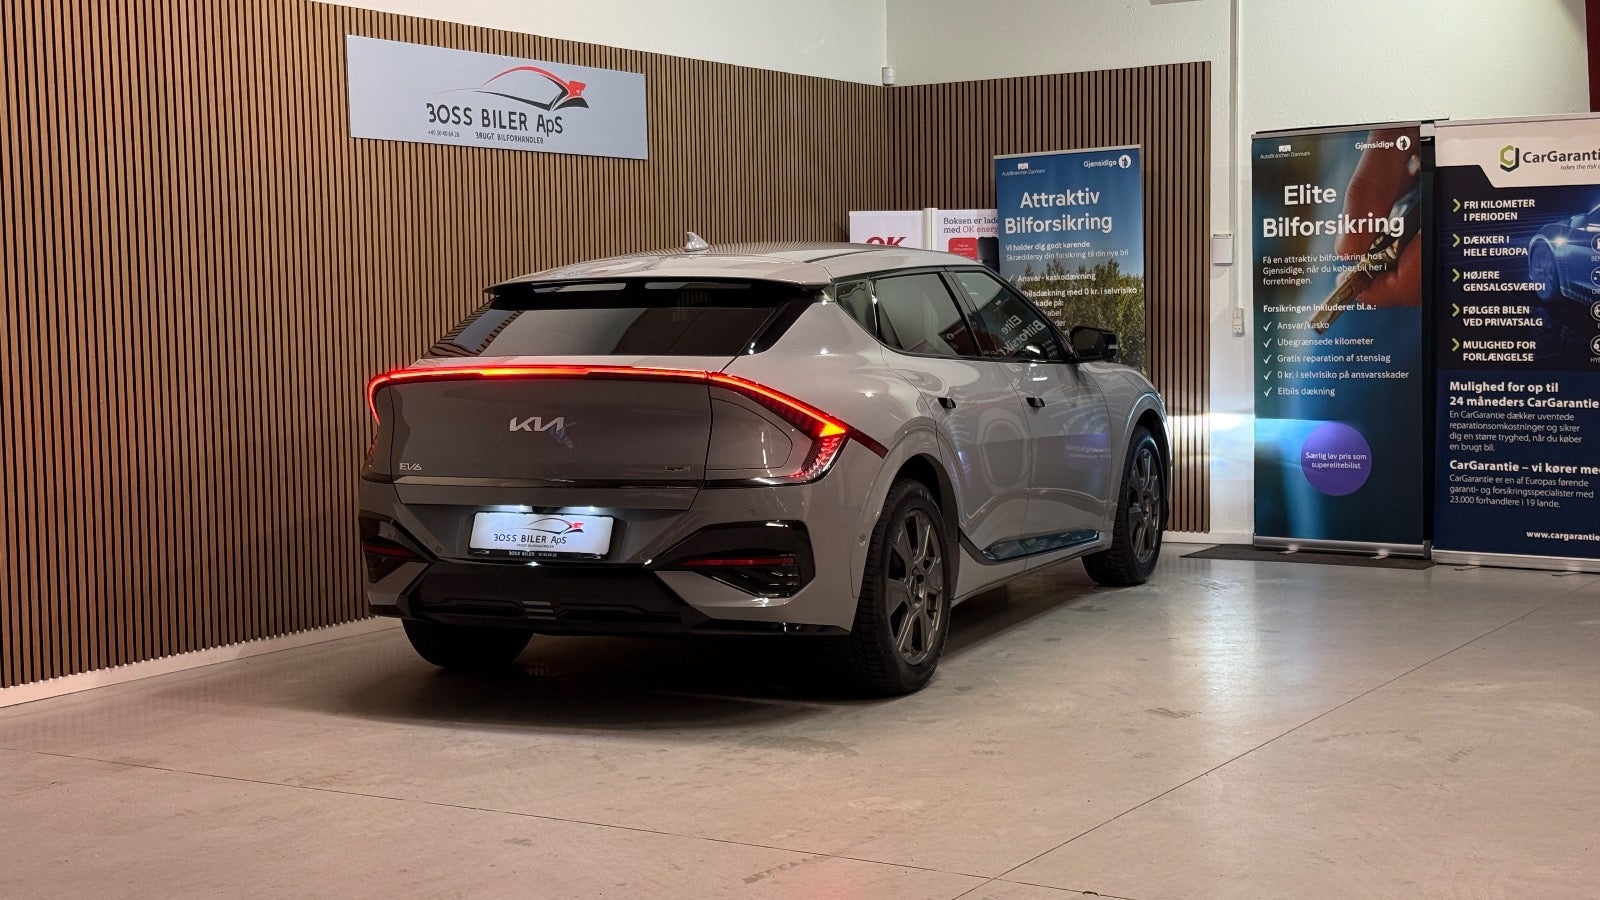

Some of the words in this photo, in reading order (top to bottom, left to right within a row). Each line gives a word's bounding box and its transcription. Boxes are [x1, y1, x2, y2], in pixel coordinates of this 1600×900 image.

[482, 109, 528, 131] BILER
[536, 114, 563, 137] ApS
[497, 134, 544, 144] BILFORHANDLER
[1355, 140, 1394, 150] Gjensidige
[1083, 160, 1117, 168] Gjensidige
[1020, 187, 1100, 209] Attraktiv
[1284, 184, 1337, 206] Elite
[1464, 201, 1478, 209] FRI
[1481, 199, 1535, 209] KILOMETER
[1469, 212, 1517, 221] PERIODEN
[1005, 213, 1112, 234] Bilforsikring
[1263, 212, 1404, 238] Bilforsikring
[977, 226, 999, 234] energ
[1463, 236, 1504, 244] DÆKKER
[1035, 243, 1045, 251] dig
[1047, 242, 1062, 251] godt
[1063, 241, 1090, 249] kørende
[1006, 253, 1042, 261] Skræddersy
[1056, 251, 1086, 260] forsikring
[1106, 250, 1118, 258] nye
[1464, 249, 1487, 257] HELE
[1490, 248, 1528, 256] EUROPA
[1263, 256, 1272, 264] Få
[1284, 255, 1317, 263] attraktiv
[1319, 253, 1365, 263] bilforsikring
[1263, 266, 1304, 276] Gjensidige,
[1306, 265, 1319, 274] når
[1321, 265, 1331, 273] du
[1332, 264, 1356, 273] køber
[1369, 263, 1383, 271] her
[1045, 272, 1096, 281] kaskodækning
[1463, 271, 1500, 279] HØJERE
[1263, 277, 1312, 286] forretningen.
[1463, 283, 1545, 292] GENSALGSVÆRDI
[1263, 304, 1311, 314] Forsikringen
[1314, 303, 1355, 312] inkluderer
[1356, 303, 1376, 311] bl.a.:
[1463, 306, 1502, 315] FØLGER
[1502, 306, 1530, 314] BILEN
[1277, 322, 1329, 330] Ansvar/kasko
[1463, 318, 1482, 326] VED
[1485, 318, 1543, 326] PRIVATSALG
[1278, 338, 1333, 347] Ubegrænsede
[1463, 341, 1514, 349] MULIGHED
[1517, 341, 1536, 349] FOR
[1278, 354, 1301, 363] Gratis
[1303, 354, 1343, 364] reparation
[1356, 354, 1391, 363] stenslag
[1463, 353, 1534, 361] FORLÆNGELSE
[1339, 370, 1349, 380] på
[1351, 371, 1409, 379] ansvarsskader
[1278, 387, 1299, 395] Elbils
[1301, 387, 1335, 397] dækning
[1450, 381, 1504, 393] Mulighed
[1507, 382, 1525, 392] for
[1527, 384, 1543, 394] op
[1546, 383, 1558, 393] til
[1450, 397, 1463, 405] 24
[1467, 396, 1525, 407] måneders
[1527, 398, 1600, 409] CarGarantie
[1450, 411, 1459, 419] En
[1461, 411, 1505, 419] CarGarantie
[1537, 413, 1574, 421] uventede
[509, 417, 564, 431] KIA
[1450, 422, 1545, 432] reparationsomkostninger
[1546, 425, 1557, 433] og
[1449, 432, 1461, 441] dig
[1498, 434, 1531, 443] tryghed,
[1532, 434, 1545, 442] når
[1547, 435, 1557, 443] du
[1559, 435, 1582, 444] køber
[1461, 443, 1482, 452] brugt
[1305, 452, 1326, 460] Særlig
[1339, 453, 1351, 461] pris
[400, 462, 422, 470] EV6
[1450, 460, 1519, 471] CarGarantie
[1532, 463, 1542, 472] vi
[1545, 463, 1577, 473] kører
[1450, 474, 1494, 483] CarGarantie
[1516, 476, 1524, 484] af
[1525, 477, 1556, 487] Europas
[1558, 478, 1589, 487] førende
[1450, 486, 1478, 494] garanti-
[1492, 487, 1573, 497] forsikringsspecialister
[1450, 496, 1474, 504] 23.000
[1476, 496, 1519, 506] forhandlere
[1536, 499, 1560, 508] lande.
[521, 535, 546, 543] BILER
[551, 536, 567, 545] ApS
